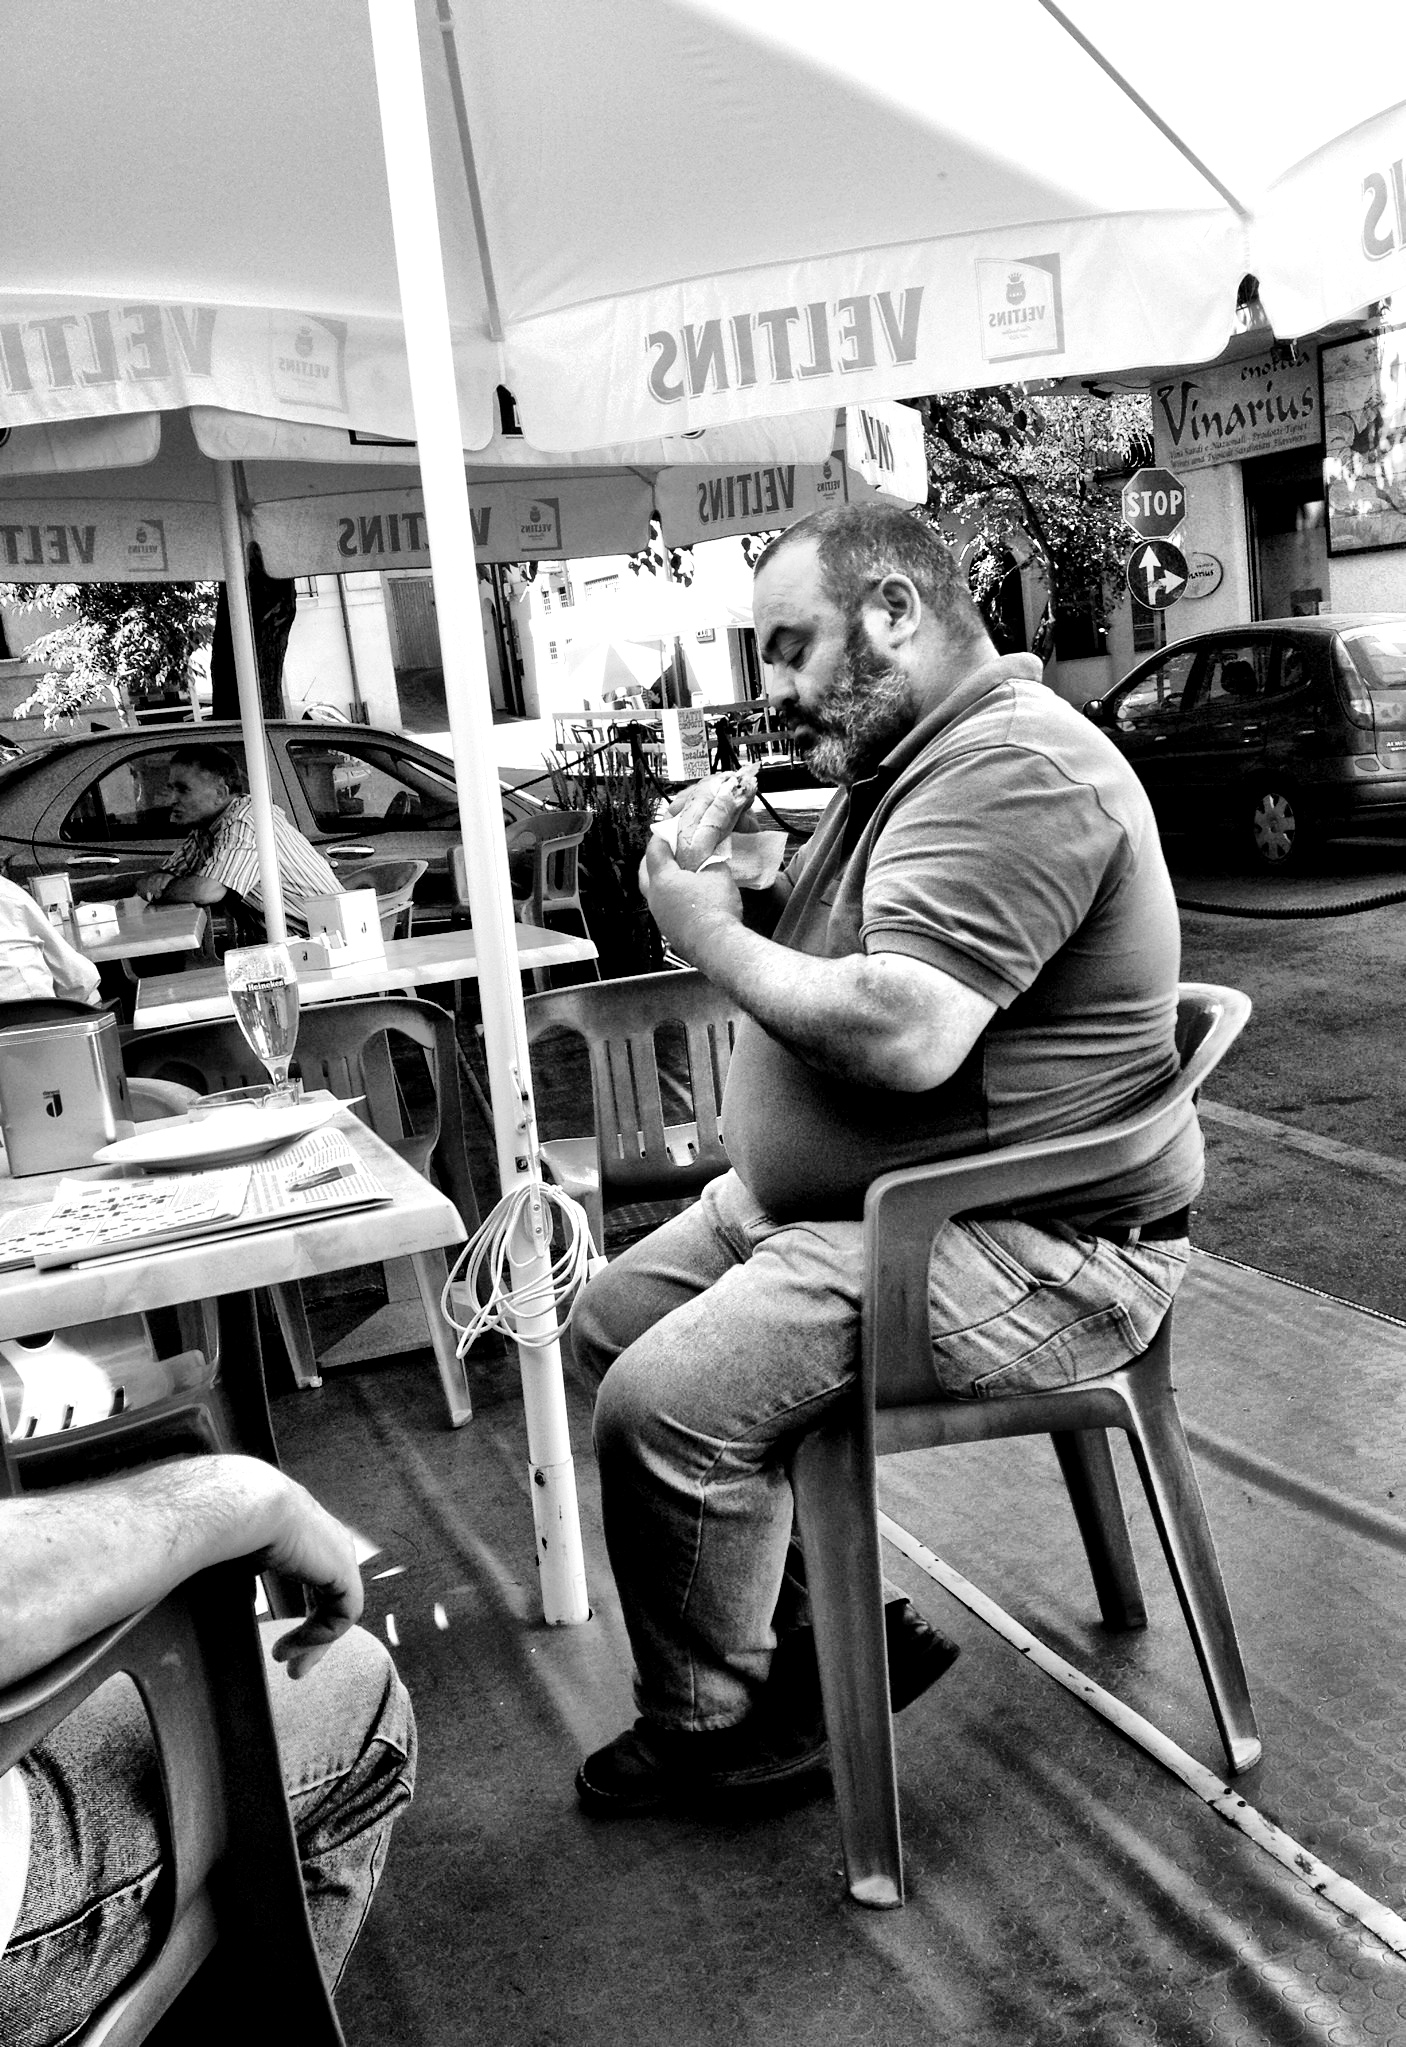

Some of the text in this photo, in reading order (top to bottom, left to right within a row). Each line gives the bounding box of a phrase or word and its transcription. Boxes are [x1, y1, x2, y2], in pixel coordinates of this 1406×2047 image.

[1157, 380, 1314, 446] Vinarius
[1126, 490, 1182, 517] STOP
[248, 980, 284, 992] Heineken
